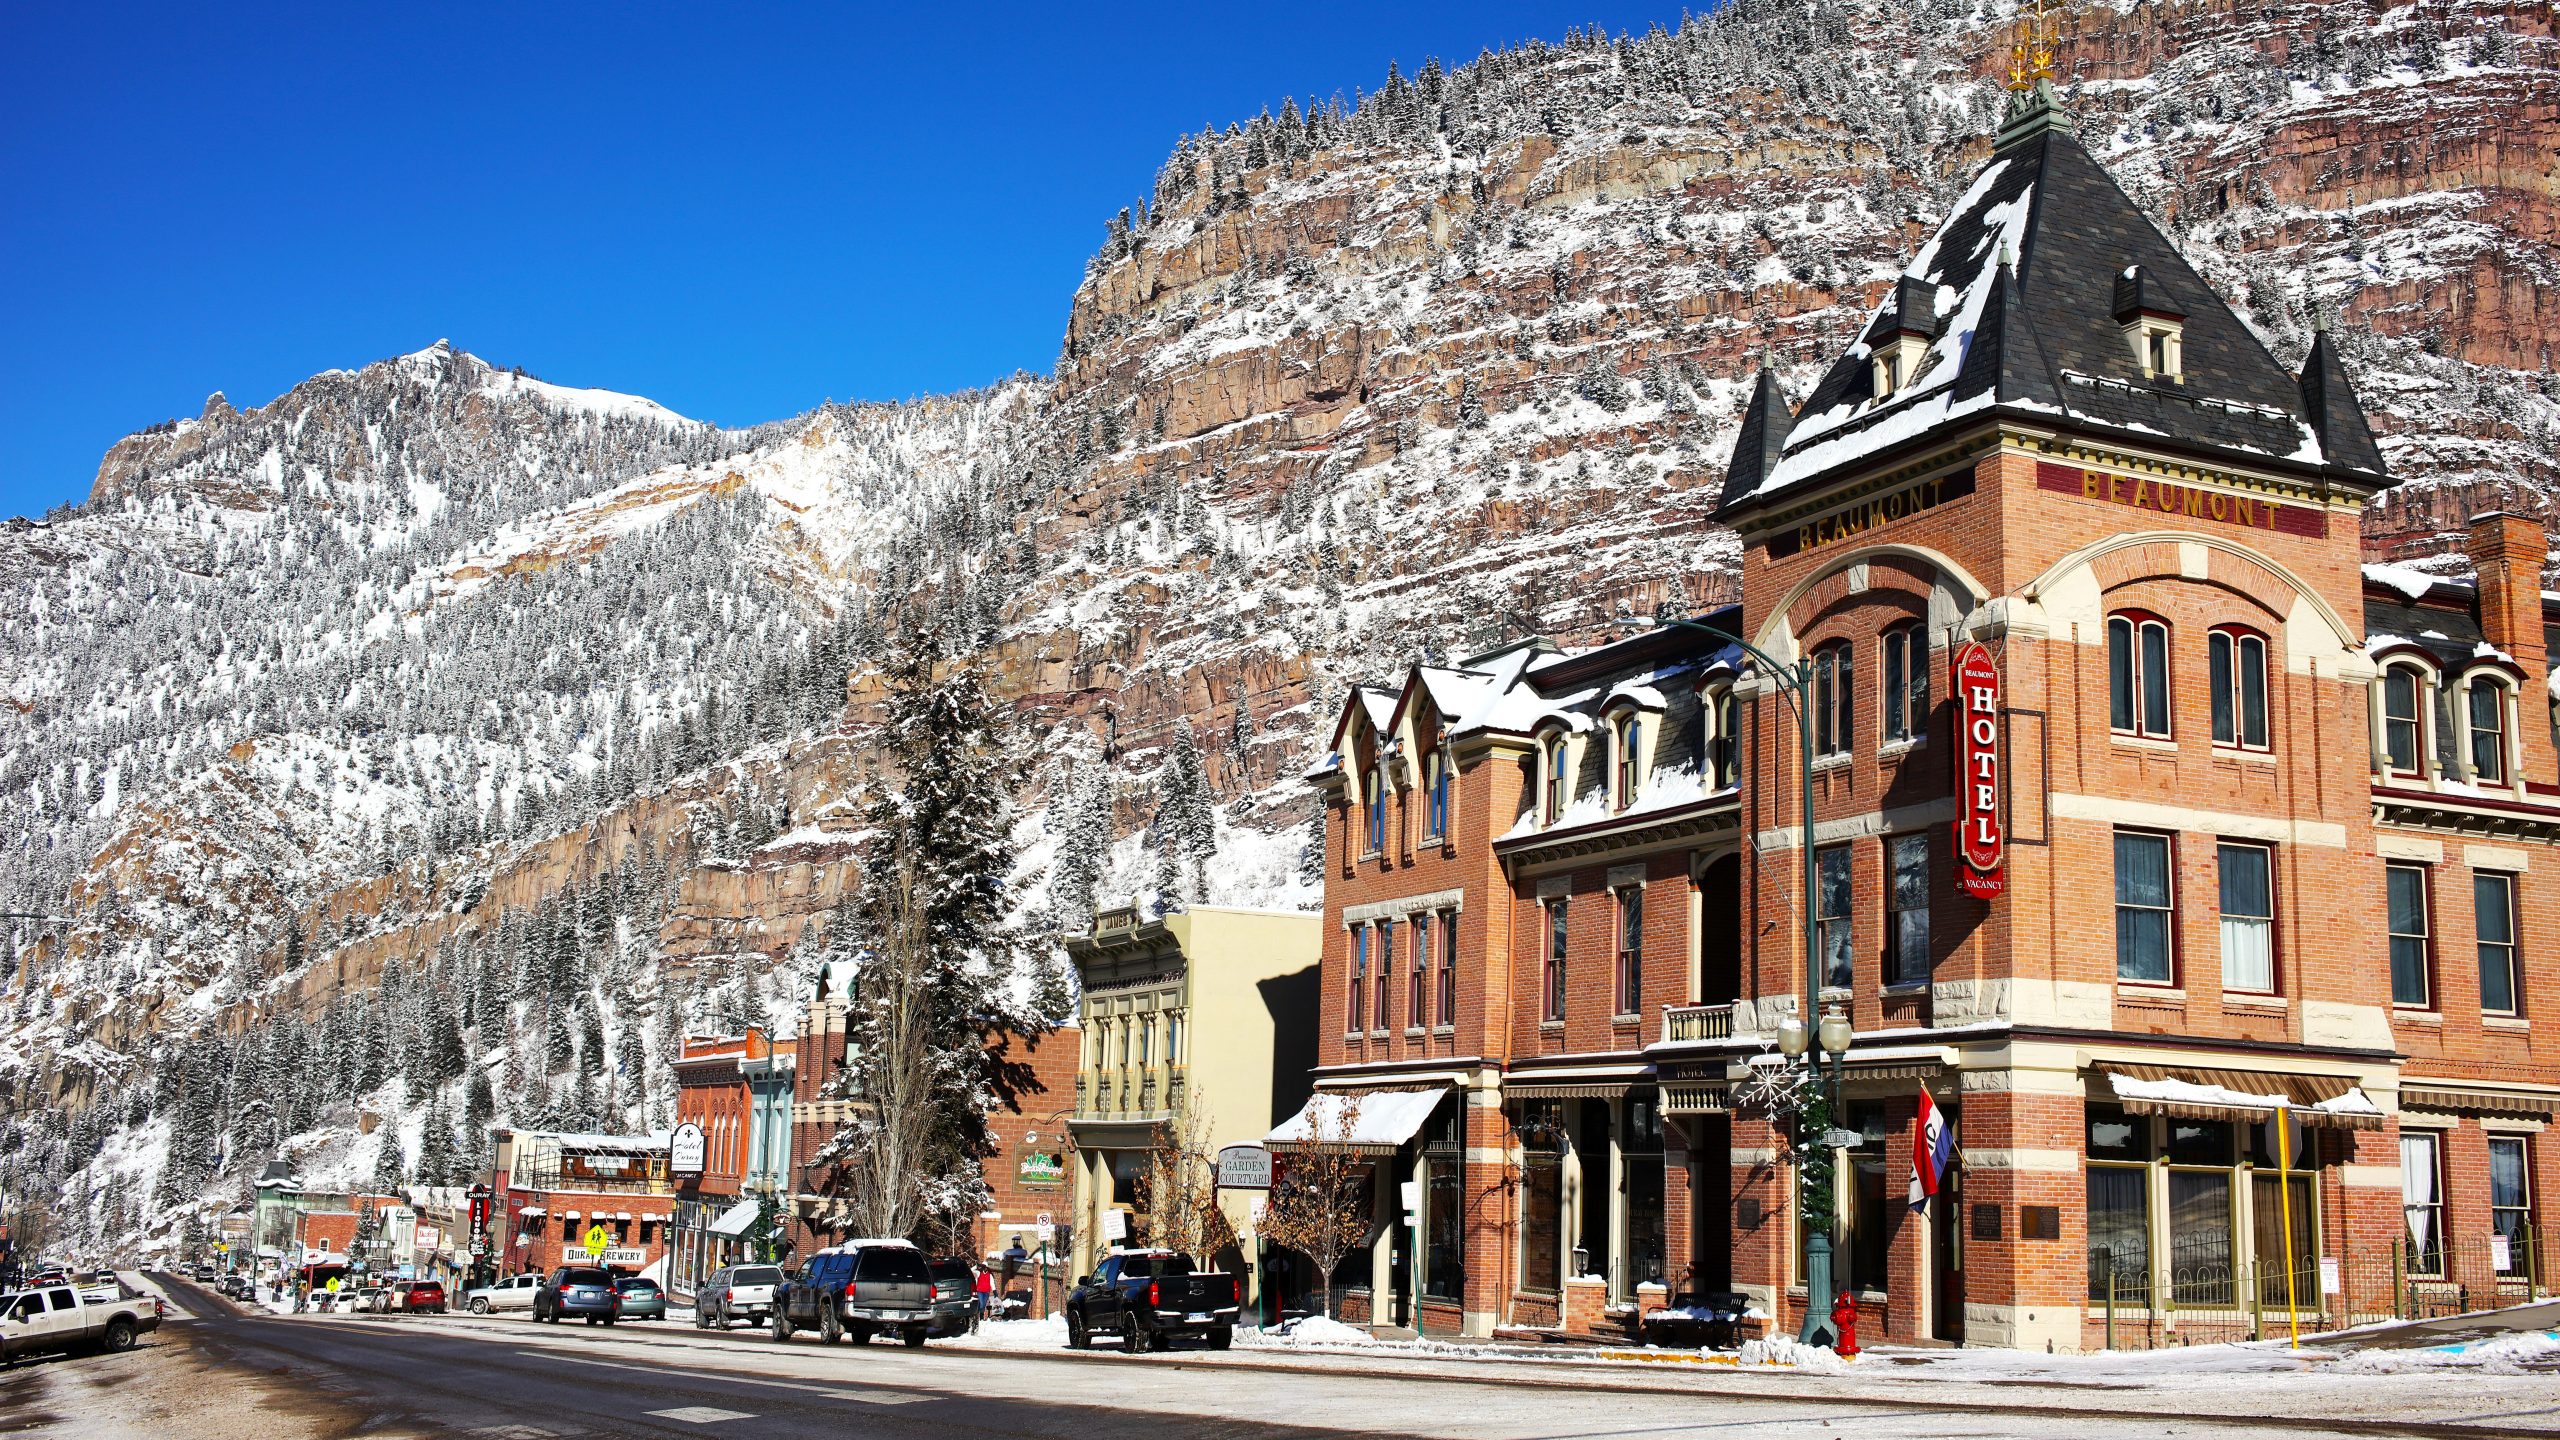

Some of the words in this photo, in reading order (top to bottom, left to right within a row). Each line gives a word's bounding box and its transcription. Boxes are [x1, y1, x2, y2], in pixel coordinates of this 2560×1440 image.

[2081, 469, 2281, 530] BEAUMONT
[1800, 478, 1944, 550] BEAUMONT
[1965, 669, 1995, 679] BEAUMONT
[1971, 685, 1996, 845] HOTEL
[1966, 879, 2003, 890] VACANCY
[1105, 914, 1128, 930] JAMES
[1677, 1063, 1707, 1079] HOTEL
[674, 1140, 702, 1151] Hotel
[674, 1151, 700, 1163] Ouray
[1225, 1160, 1266, 1172] GARDEN
[1220, 1173, 1270, 1185] COURTYARD
[568, 1249, 595, 1260] OURA
